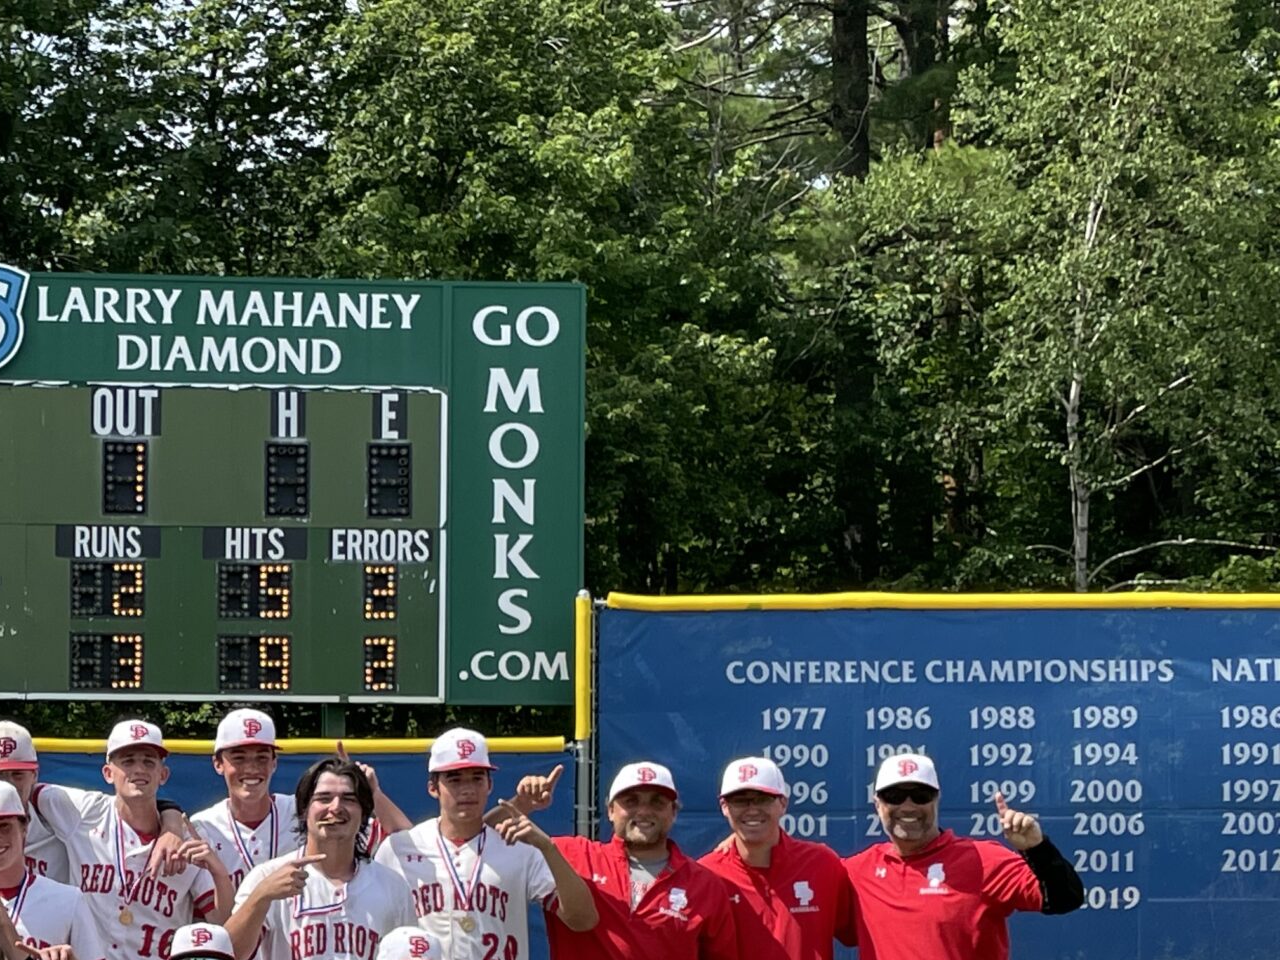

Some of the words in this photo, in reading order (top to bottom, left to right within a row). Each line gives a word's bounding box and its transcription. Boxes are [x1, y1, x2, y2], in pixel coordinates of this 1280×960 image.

[38, 286, 182, 324] LARRY
[196, 289, 420, 329] MAHANEY
[472, 305, 559, 346] GO
[117, 334, 341, 374] DIAMOND
[92, 388, 158, 436] OUT
[278, 391, 297, 437] H
[381, 393, 399, 439] E
[483, 368, 544, 634] MONKS
[74, 526, 141, 559] RUNS
[225, 527, 285, 560] HITS
[332, 528, 429, 562] ERRORS
[113, 564, 142, 616] 2
[259, 565, 289, 618] 5
[364, 566, 395, 619] 2
[112, 635, 142, 688] 3
[259, 637, 289, 690] 9
[458, 650, 569, 681] .COM
[726, 660, 917, 684] CONFERENCE
[925, 659, 1174, 682] CHAMPIONSHIPS
[761, 708, 826, 730] 1977
[866, 706, 932, 730] 1986
[970, 706, 1035, 729] 1988
[1072, 706, 1138, 729] 1989
[970, 744, 1034, 766] 1992
[1073, 743, 1138, 766] 1994
[785, 782, 828, 804] 96
[1071, 780, 1142, 803] 2000
[780, 814, 827, 837] 001
[1073, 813, 1144, 835] 2006
[1074, 850, 1134, 873] 2011
[81, 864, 115, 893] RED
